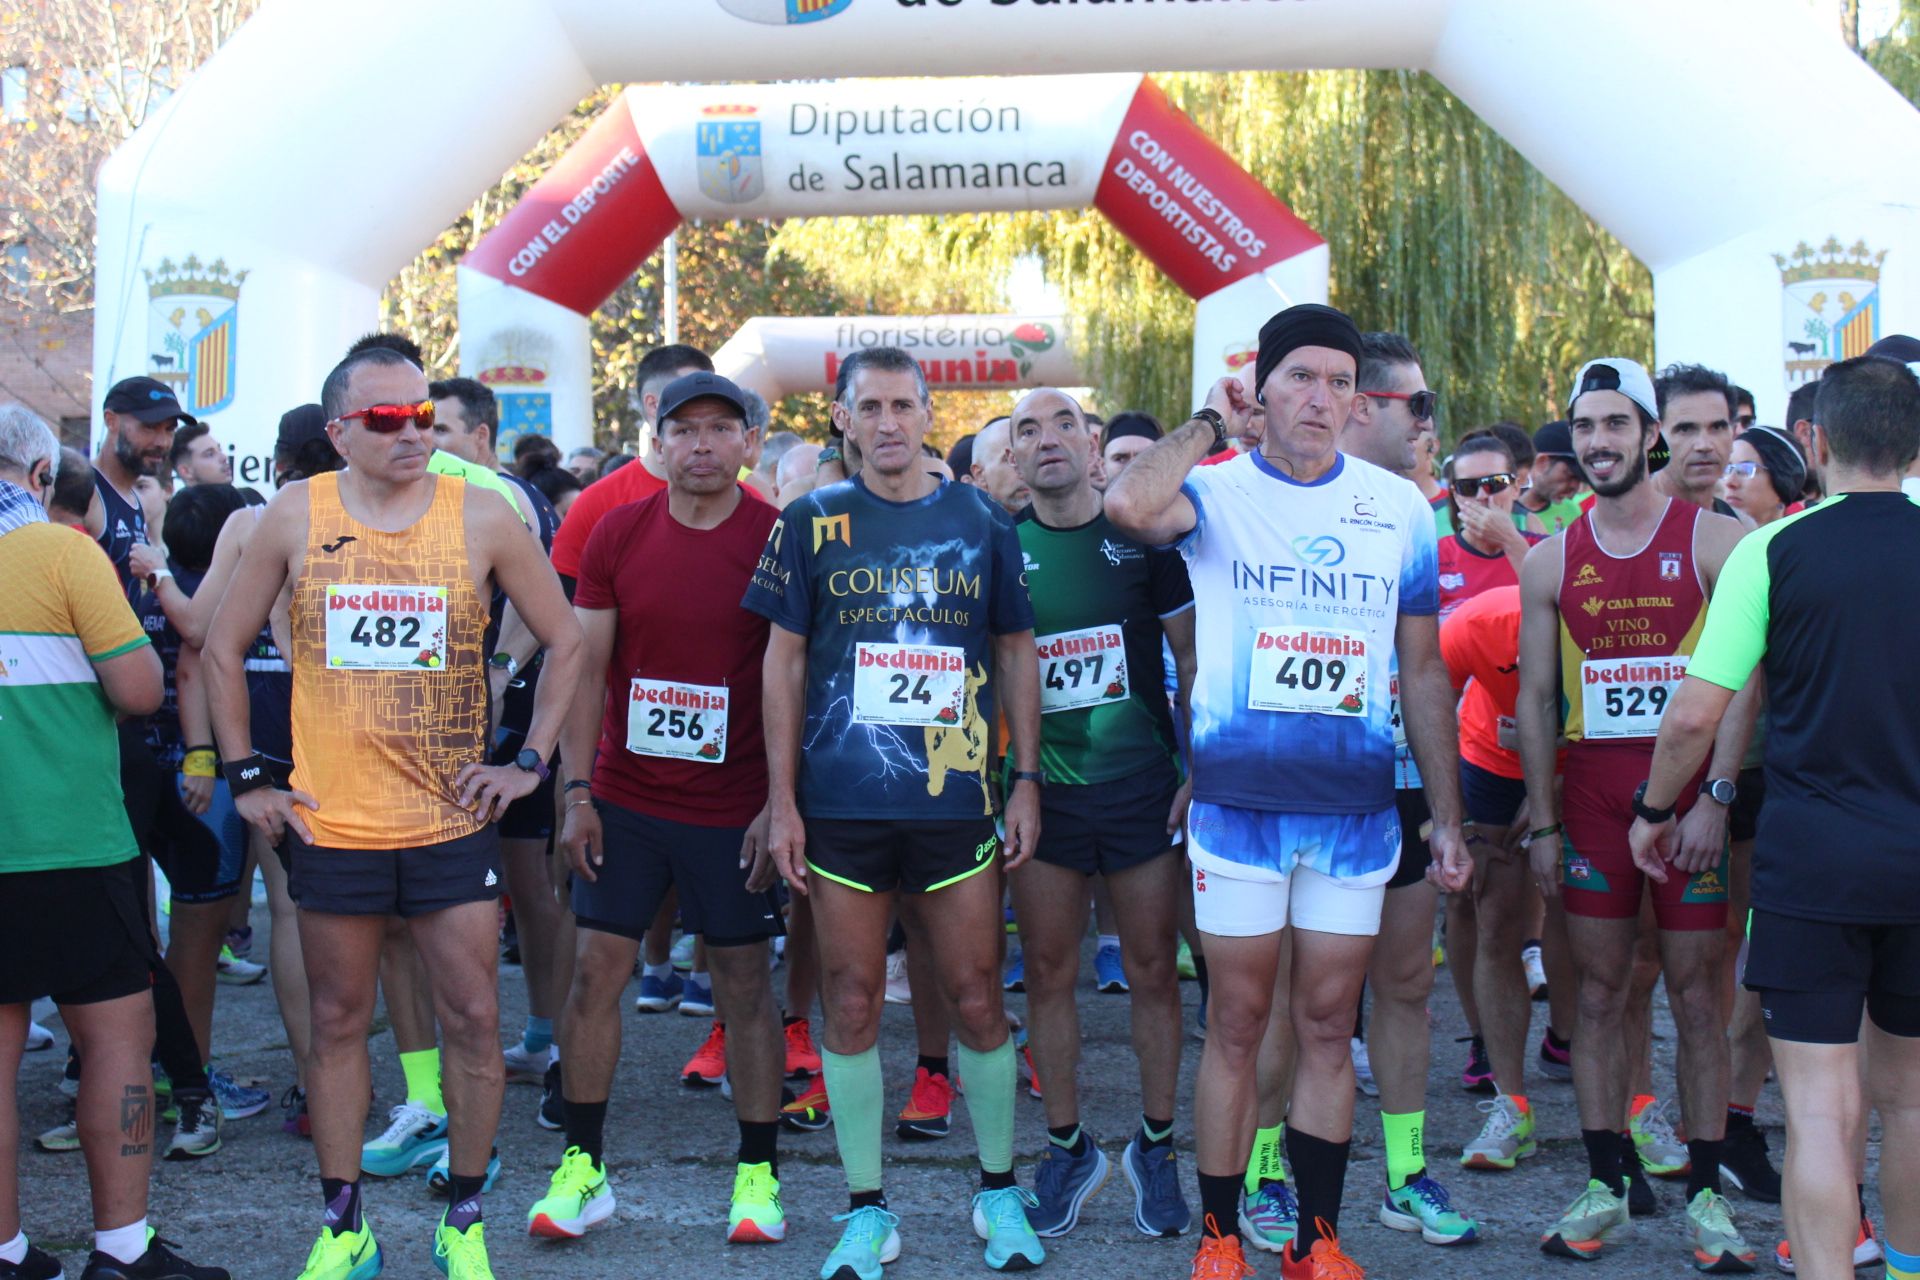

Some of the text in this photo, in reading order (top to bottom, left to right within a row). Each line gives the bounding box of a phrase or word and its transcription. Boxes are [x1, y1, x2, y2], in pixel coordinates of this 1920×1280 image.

[789, 98, 1021, 145] Diputación
[789, 152, 1067, 192] de Salamanca
[1129, 130, 1267, 258] CON NUESTROS
[508, 146, 641, 277] CON EL DEPORTE
[1114, 157, 1238, 272] DEPORTISTAS
[825, 351, 1018, 384] unia
[756, 555, 791, 585] SEUM
[828, 567, 982, 599] COLISEUM
[1024, 563, 1041, 571] TOR
[1233, 560, 1394, 605] INFINITY
[329, 591, 443, 612] bedunia
[839, 607, 969, 627] ESPECTACULOS
[1244, 596, 1386, 618] ASESORÍA ENERGÉTICA
[1607, 597, 1674, 610] CAJA RURAL
[350, 616, 420, 648] 482
[1606, 617, 1650, 632] VINO
[1037, 631, 1121, 660] edunia
[1256, 631, 1365, 657] bedunia
[1592, 633, 1667, 649] DE TORO
[859, 647, 963, 673] bedunia
[1046, 654, 1104, 691] 497
[1275, 656, 1346, 692] 409
[1584, 661, 1687, 685] bedunia
[632, 683, 726, 710] bedunia
[889, 673, 932, 705] 24
[1606, 686, 1668, 718] 529
[647, 708, 704, 741] 256
[1410, 1127, 1420, 1157] CYCLES
[1259, 1142, 1271, 1175] VALWIND
